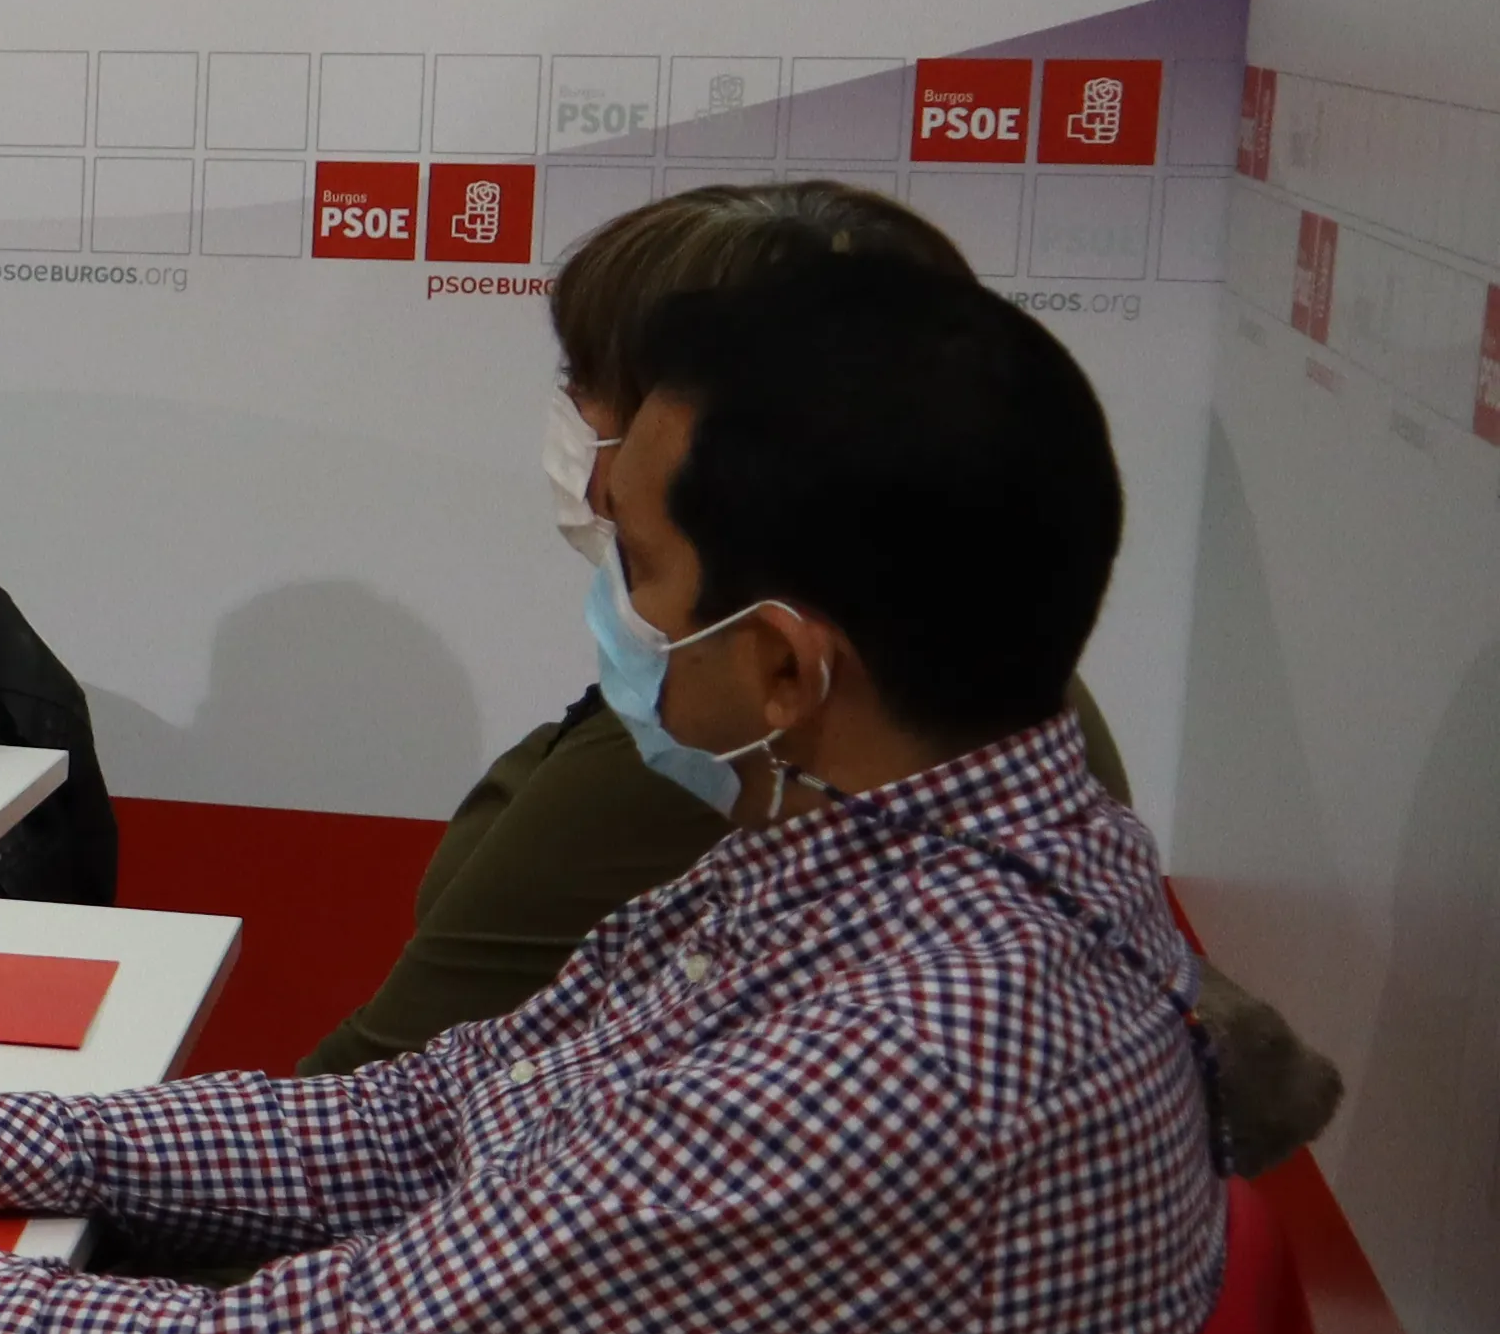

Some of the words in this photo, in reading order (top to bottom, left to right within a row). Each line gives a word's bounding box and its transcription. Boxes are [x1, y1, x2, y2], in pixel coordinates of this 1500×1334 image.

[924, 89, 973, 105] Burgos
[921, 106, 1021, 141] PSOE
[323, 189, 367, 205] Burgos
[320, 207, 410, 239] PSOE
